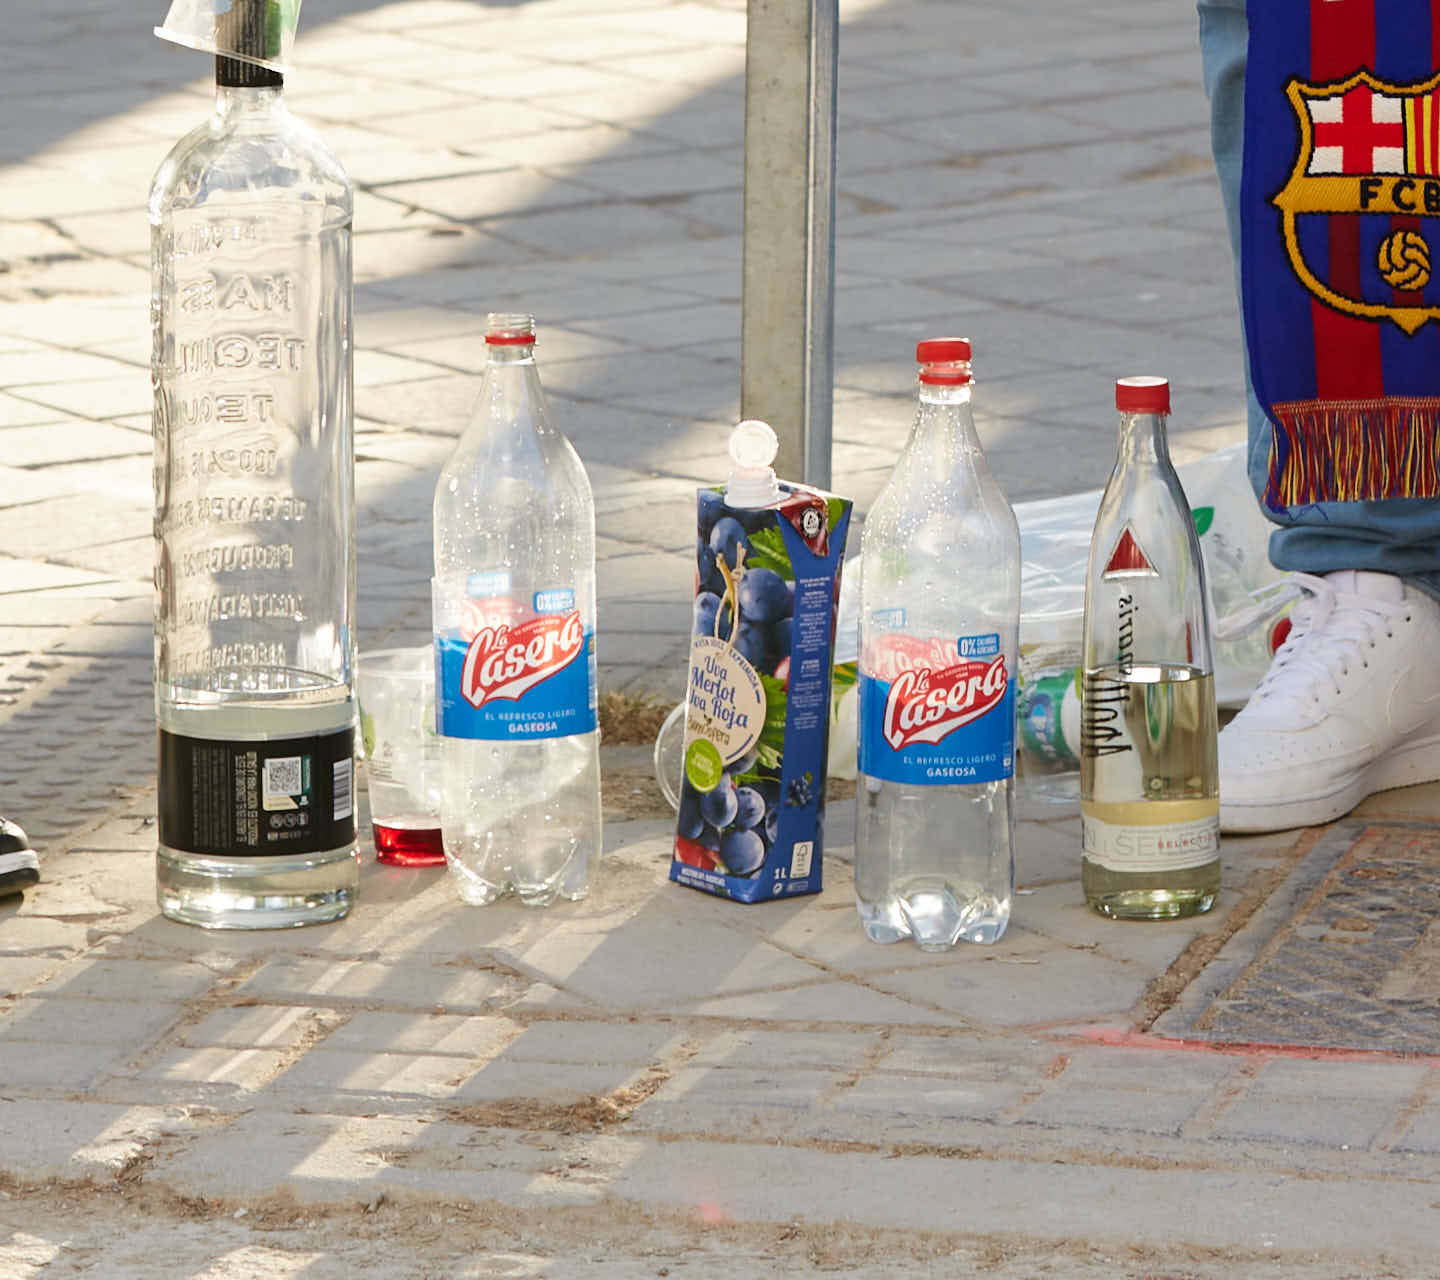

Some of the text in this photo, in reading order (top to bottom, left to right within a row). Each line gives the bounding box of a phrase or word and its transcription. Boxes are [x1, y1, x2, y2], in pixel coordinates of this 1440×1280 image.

[491, 624, 510, 651] La
[463, 611, 581, 708] Casera
[704, 655, 728, 681] Uva
[691, 666, 736, 705] Merlot
[911, 668, 931, 694] La
[497, 710, 546, 721] REFRESCO
[710, 696, 750, 731] Roja
[883, 656, 1006, 750] Casera
[508, 721, 559, 734] GASEOSA
[903, 756, 914, 765] EL
[916, 755, 964, 766] REFRESCO
[926, 766, 977, 778] GASEOSA
